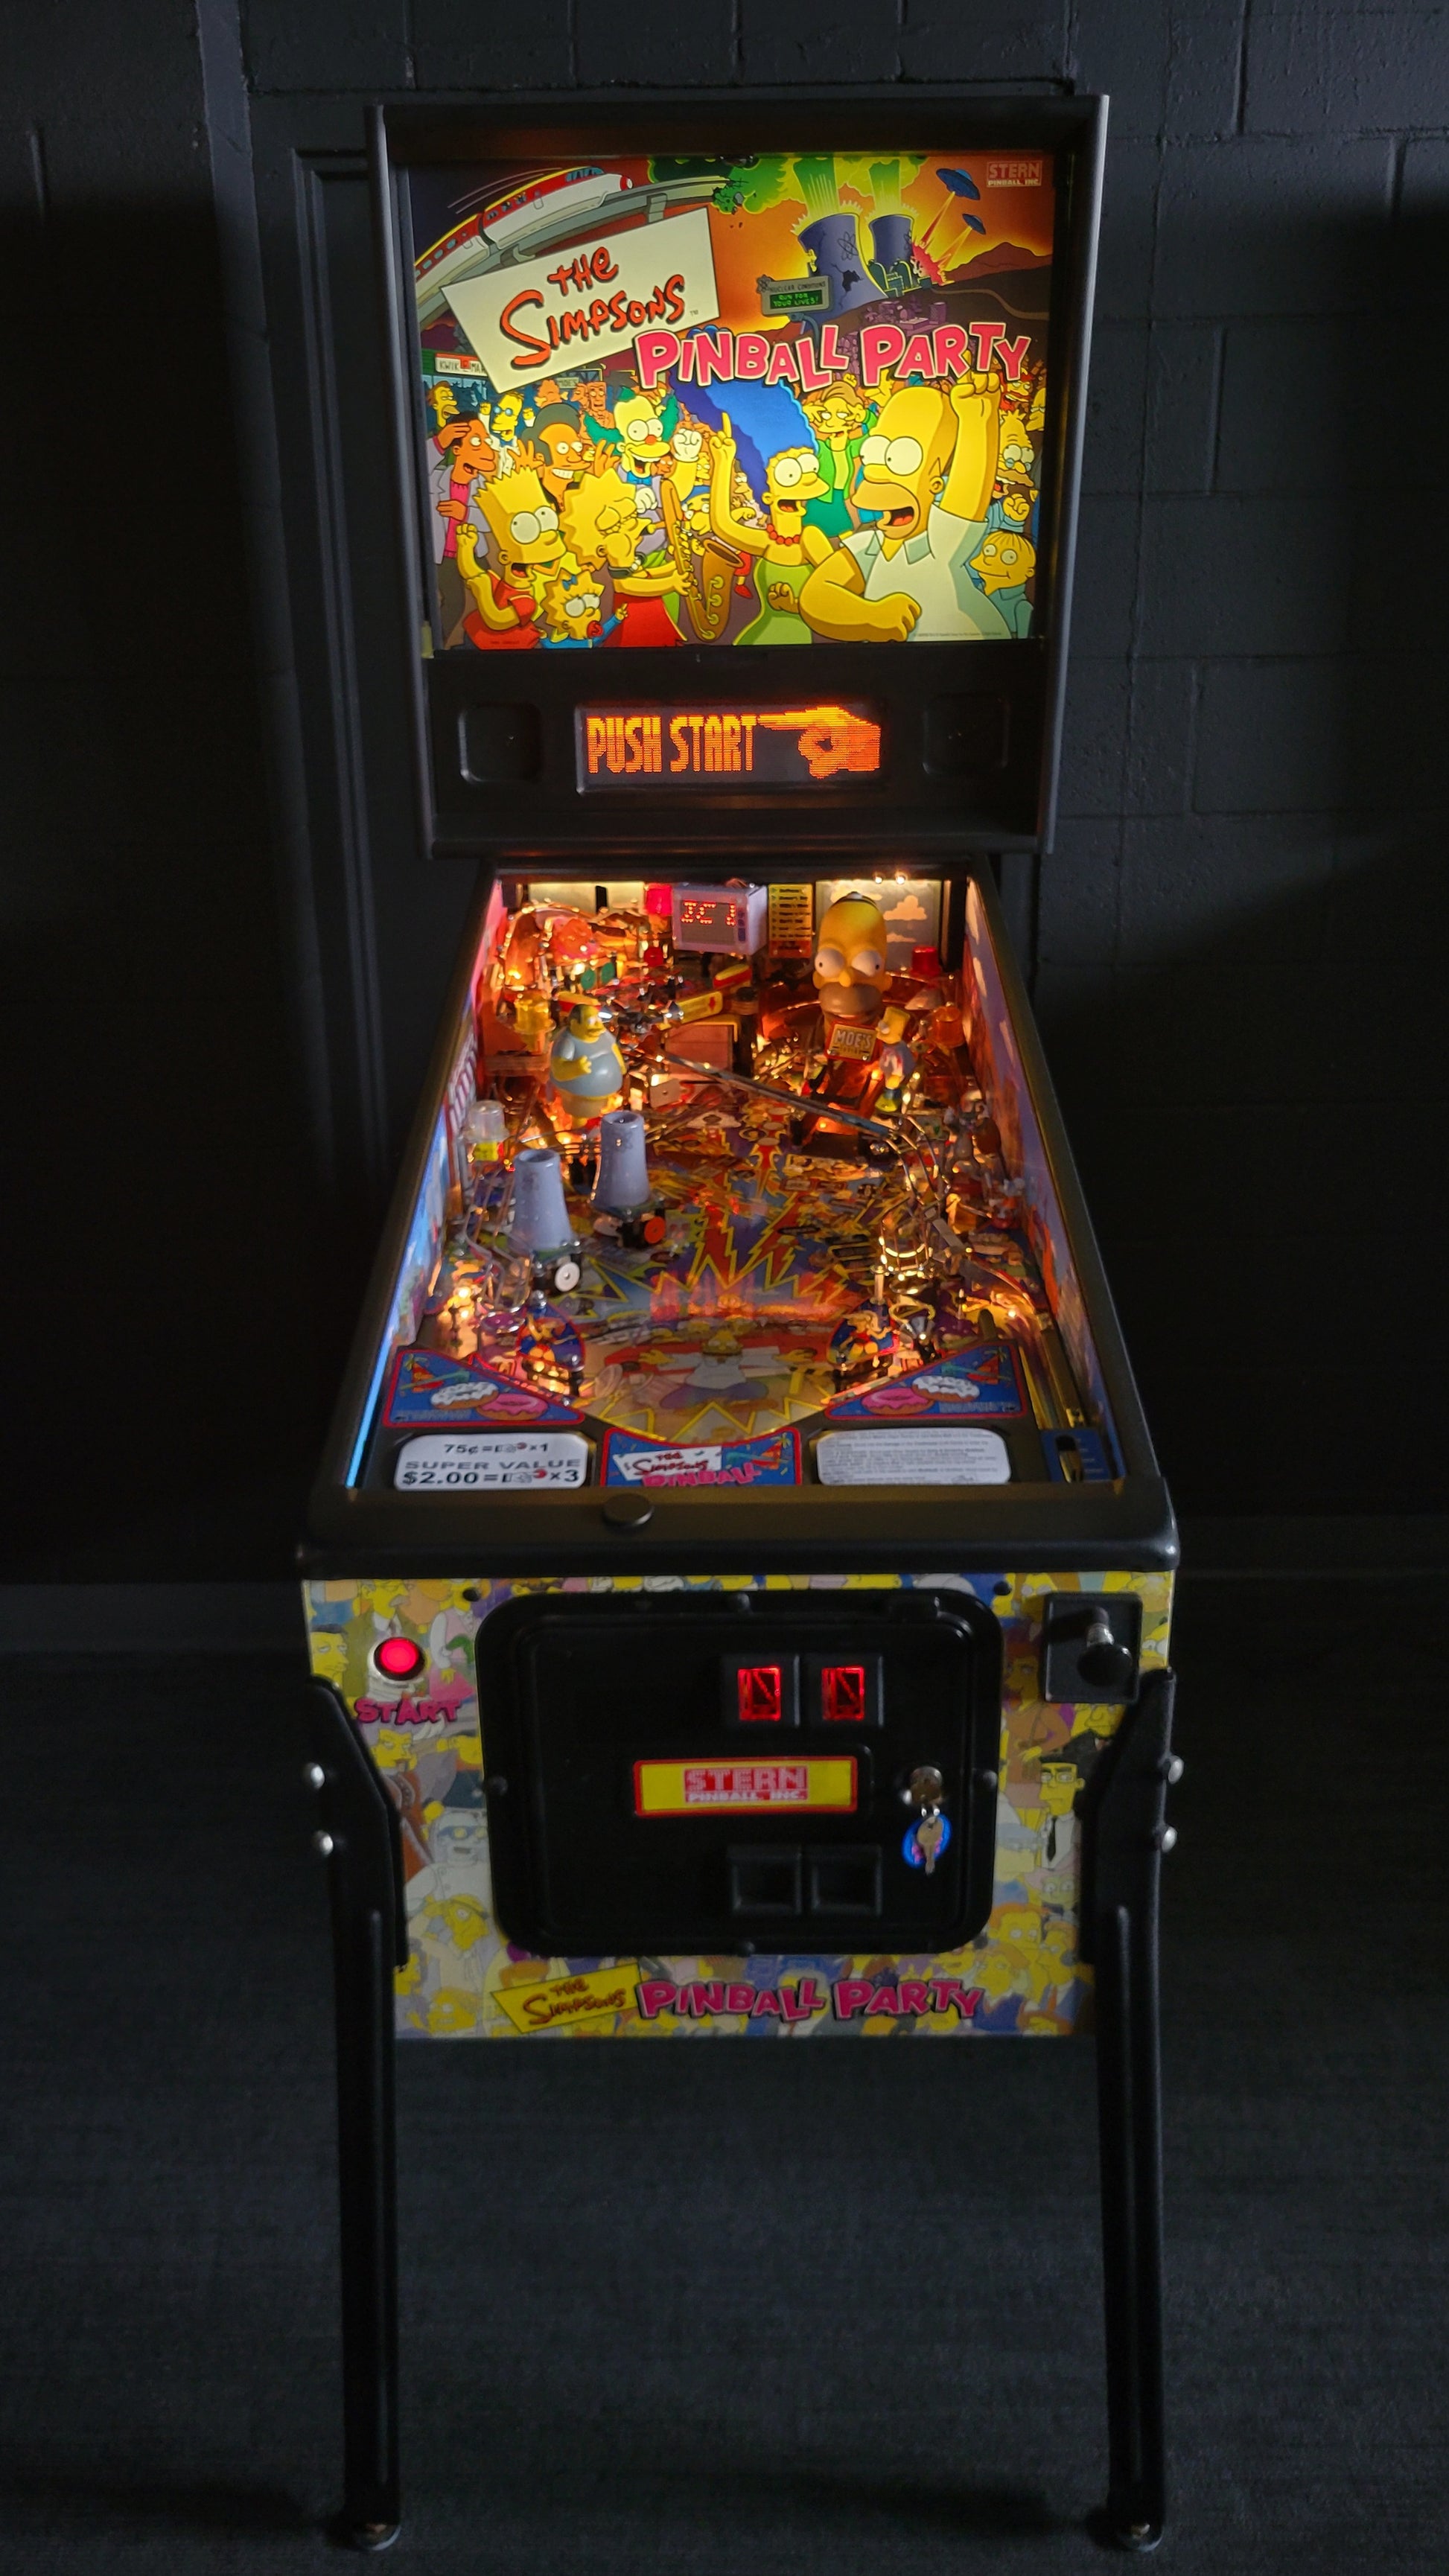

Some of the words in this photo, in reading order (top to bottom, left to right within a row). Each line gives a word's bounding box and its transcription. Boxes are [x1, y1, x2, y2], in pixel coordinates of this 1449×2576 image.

[988, 162, 1040, 179] STERN
[633, 323, 850, 393] PINBALL
[859, 321, 1032, 387] PARTY
[587, 715, 662, 774] PUSH
[670, 714, 757, 773] START
[835, 1030, 872, 1049] MOE'S
[405, 1460, 489, 1470] SUPER
[499, 1458, 582, 1470] VALUE
[642, 1461, 762, 1487] PINBALL
[354, 1697, 462, 1726] START
[687, 1766, 805, 1791] STERN
[635, 1977, 826, 2022] PINBALL
[834, 1977, 985, 2021] PARTY
